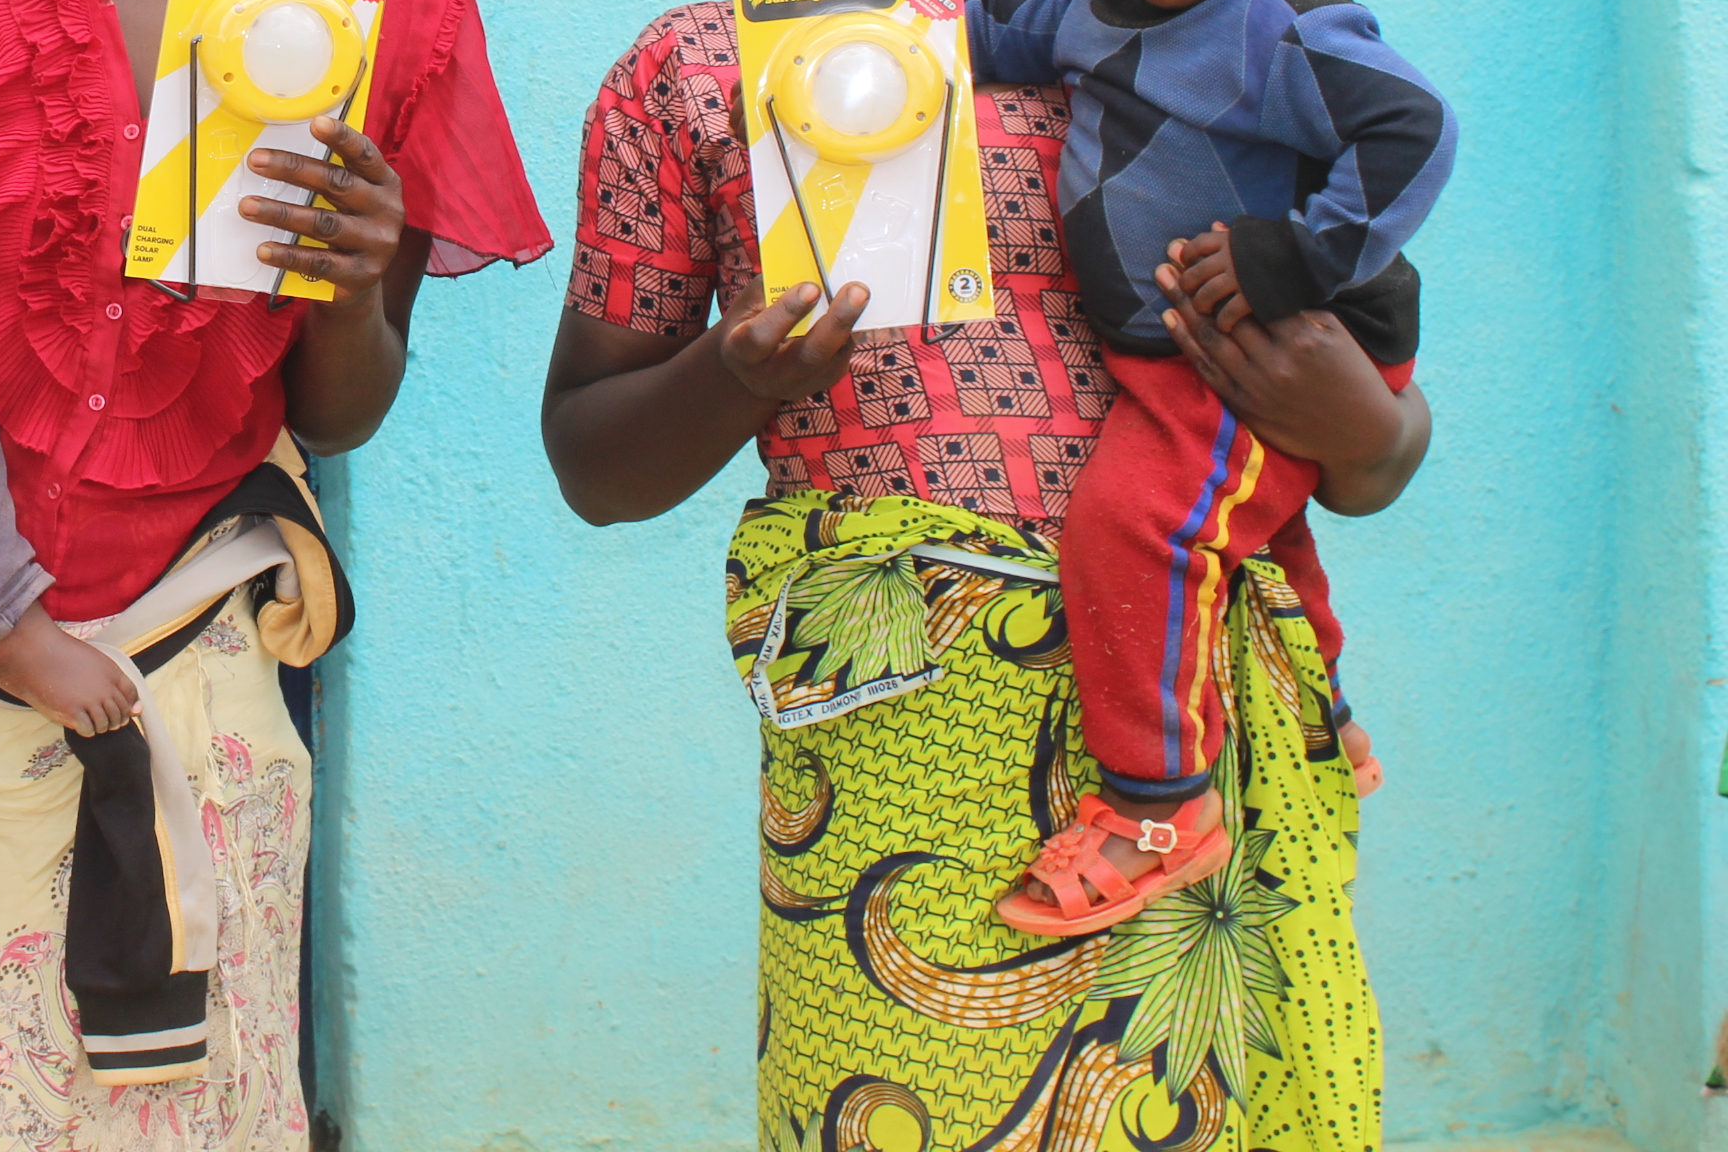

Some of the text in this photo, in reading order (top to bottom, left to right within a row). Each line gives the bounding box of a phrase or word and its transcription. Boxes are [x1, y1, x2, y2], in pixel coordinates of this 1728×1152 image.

[137, 225, 157, 234] DUAL
[136, 235, 174, 245] CHARGING
[134, 245, 159, 253] SOLAR
[132, 255, 154, 263] LAMP
[959, 277, 971, 290] 2
